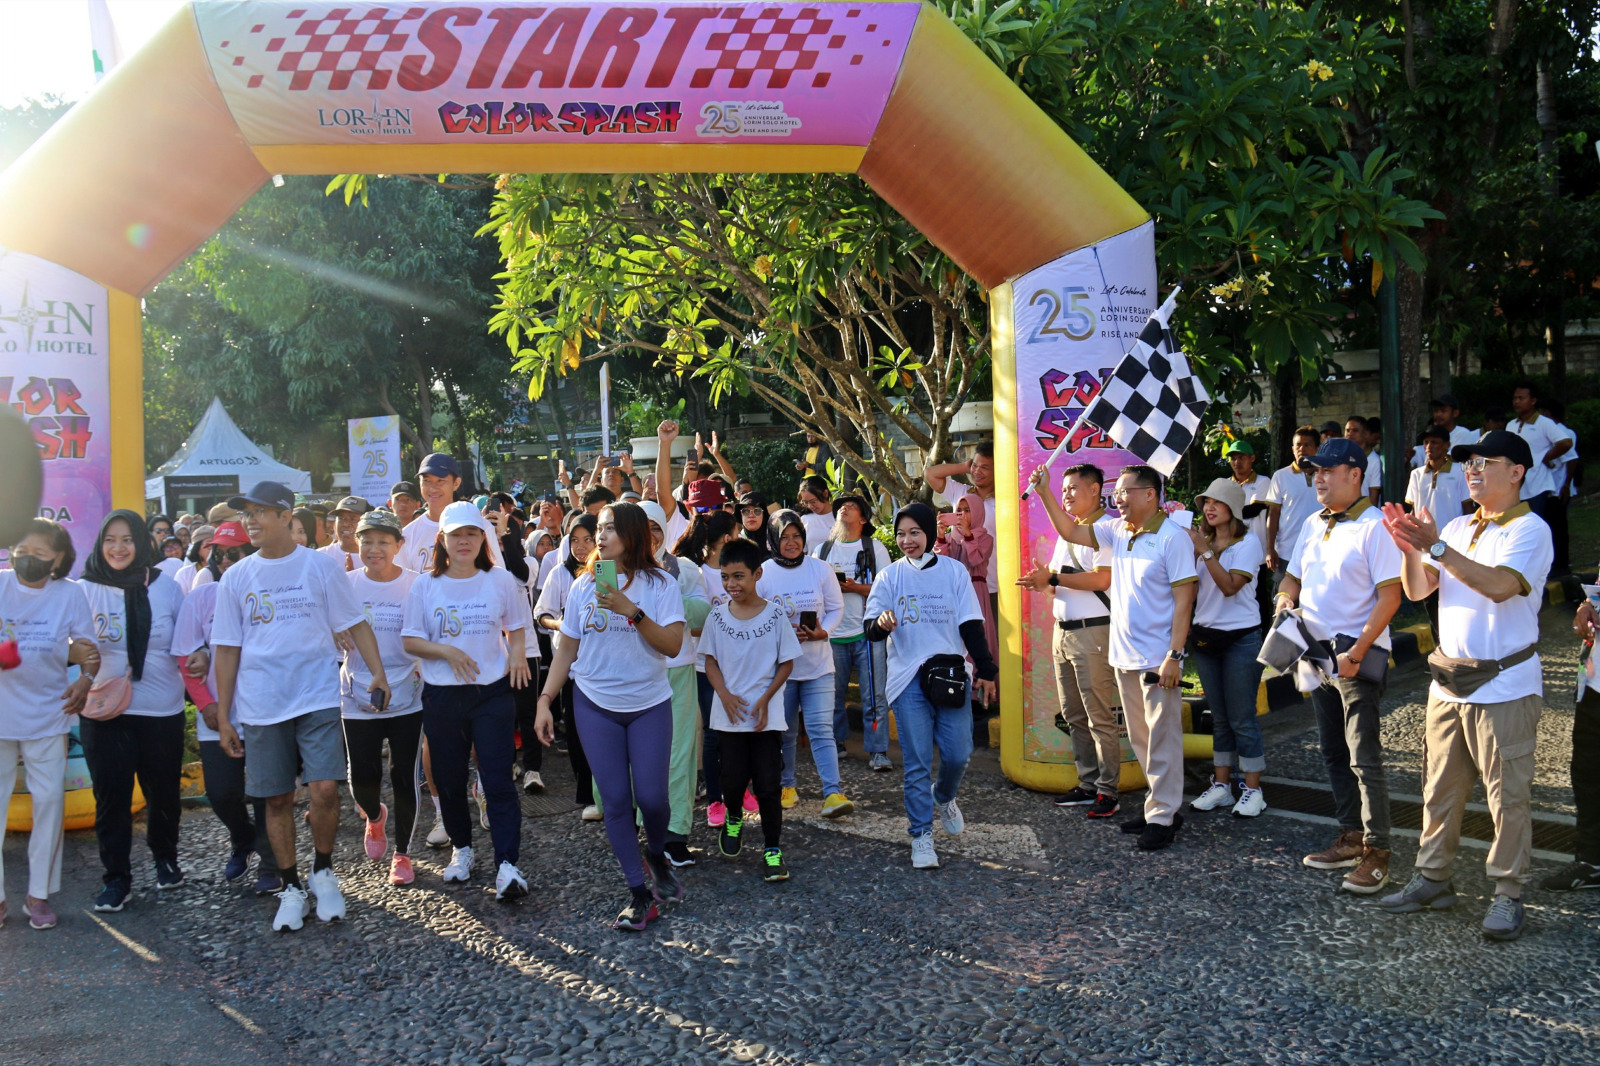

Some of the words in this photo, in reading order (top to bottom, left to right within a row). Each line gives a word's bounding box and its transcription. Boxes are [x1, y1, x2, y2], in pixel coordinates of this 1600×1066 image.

[397, 7, 721, 91] START
[438, 101, 559, 134] COLOR
[558, 101, 682, 135] SPLASH
[1130, 316, 1147, 324] SOLO
[37, 340, 97, 356] HOTEL
[200, 458, 244, 466] ARTUGO
[362, 450, 388, 478] 25
[753, 608, 783, 638] LEGEND
